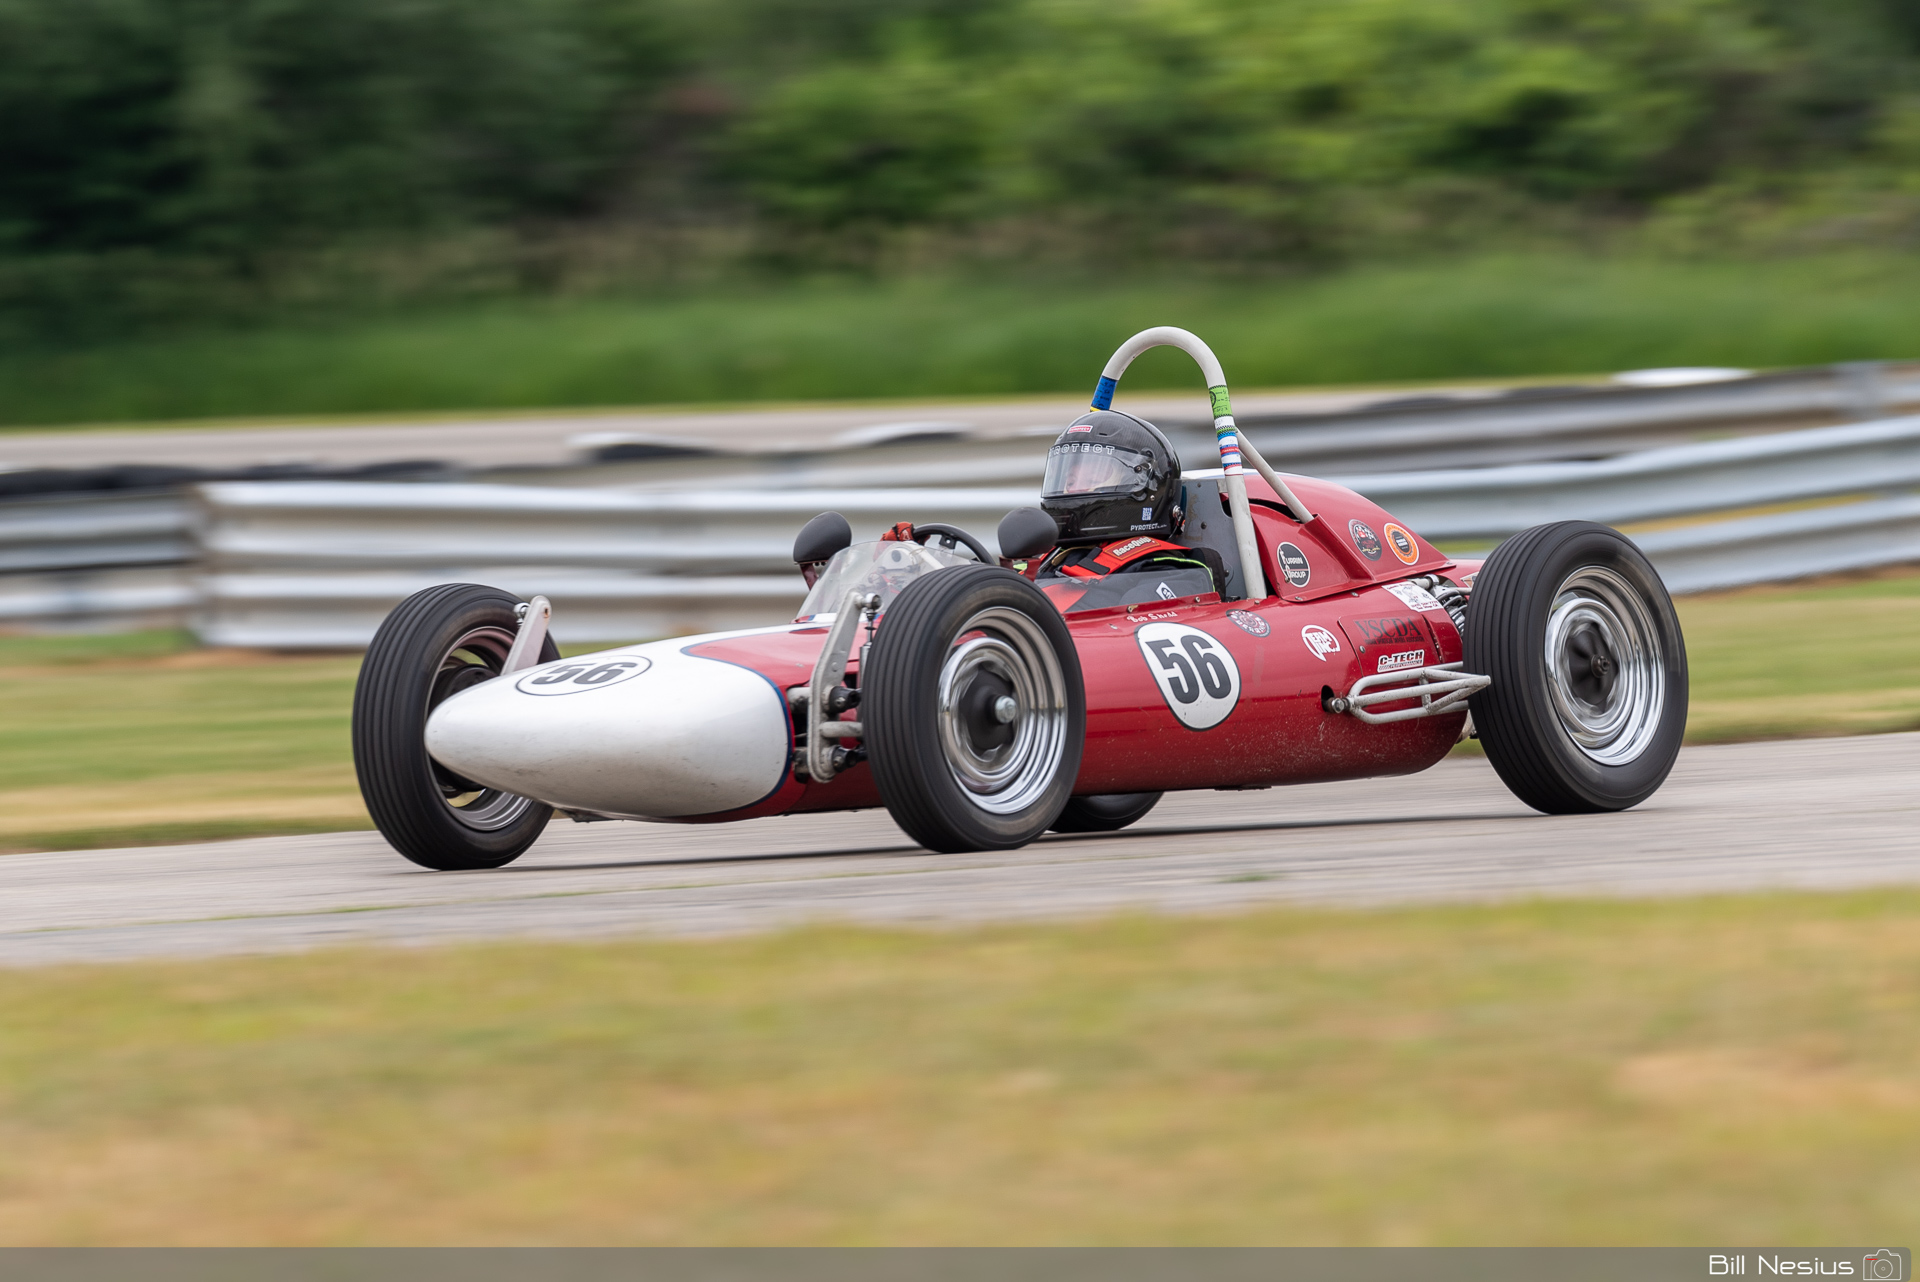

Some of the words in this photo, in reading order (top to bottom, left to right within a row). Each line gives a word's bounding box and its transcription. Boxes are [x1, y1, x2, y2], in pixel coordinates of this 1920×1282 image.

[1130, 523, 1158, 531] PYROTECT
[1112, 536, 1152, 556] RaceQuip
[1355, 617, 1421, 638] VSCDA
[1380, 651, 1423, 665] C-TECH
[531, 662, 638, 685] 56
[1145, 634, 1231, 704] 56
